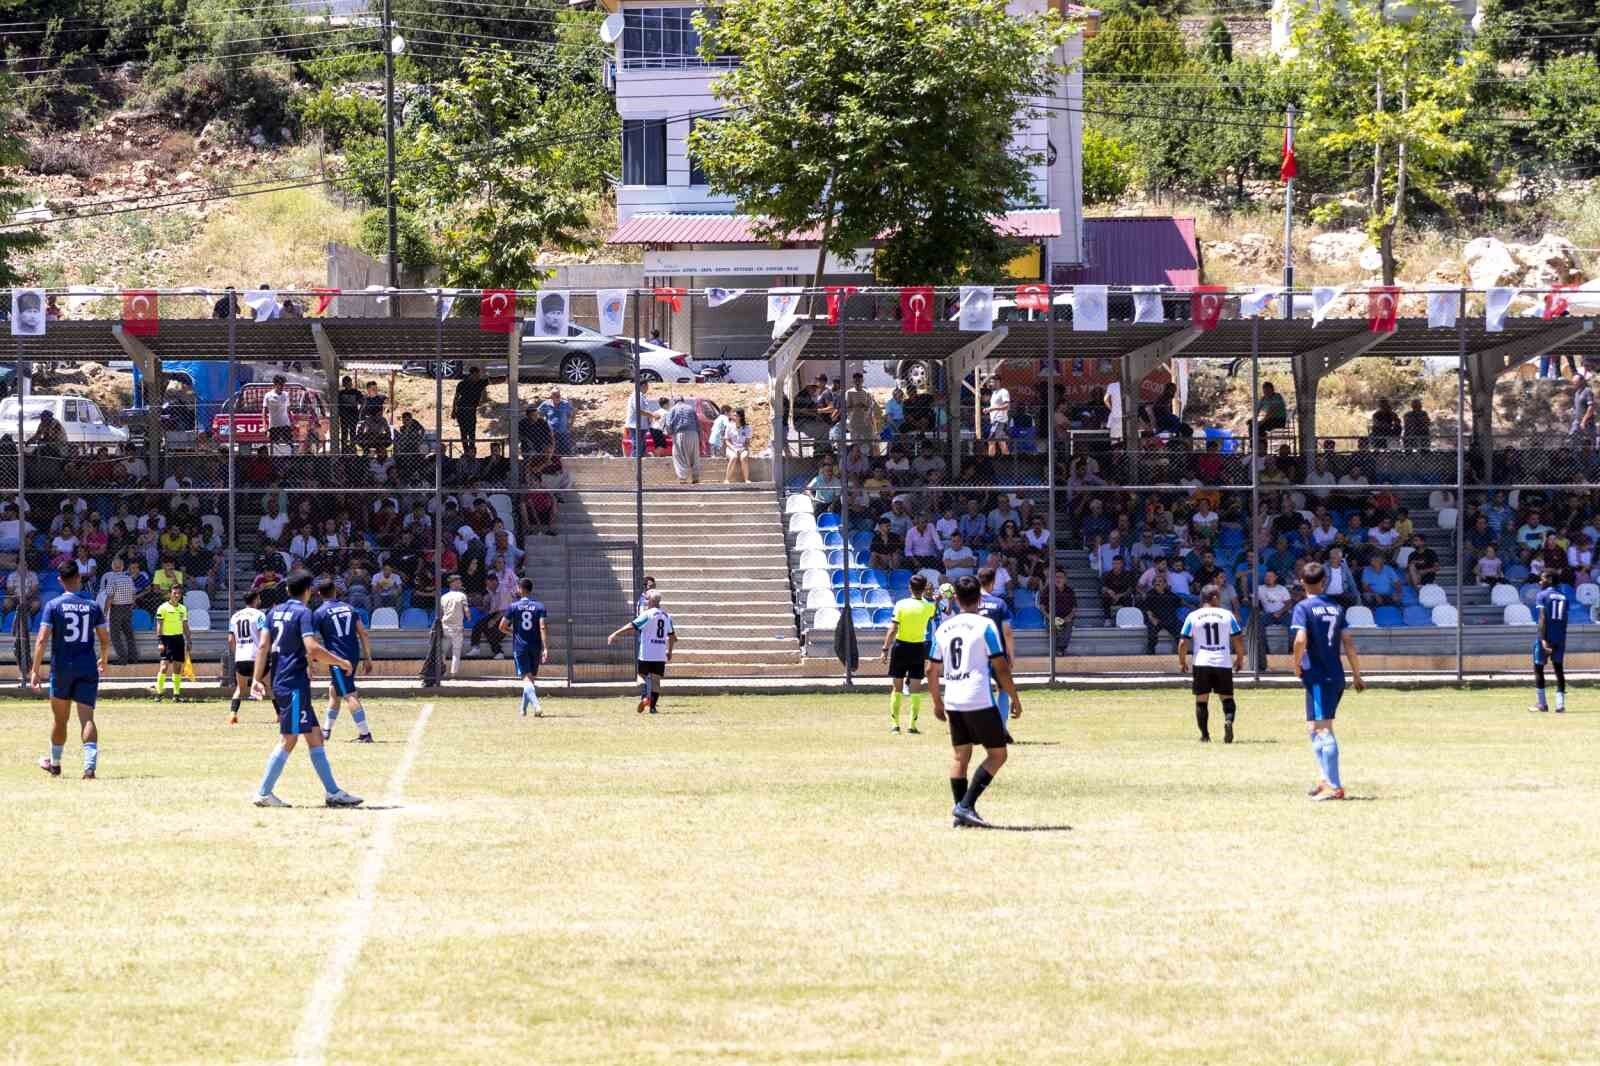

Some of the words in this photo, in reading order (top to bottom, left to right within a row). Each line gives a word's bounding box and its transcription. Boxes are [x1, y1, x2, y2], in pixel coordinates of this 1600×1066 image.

[521, 611, 533, 631] 8
[1552, 600, 1564, 620] 11
[64, 612, 90, 643] 31
[236, 619, 251, 639] 10
[331, 613, 352, 637] 17
[656, 618, 665, 639] 8
[1202, 622, 1220, 646] 11
[1322, 615, 1337, 647] 7
[950, 636, 963, 671] 6
[300, 710, 309, 724] 2
